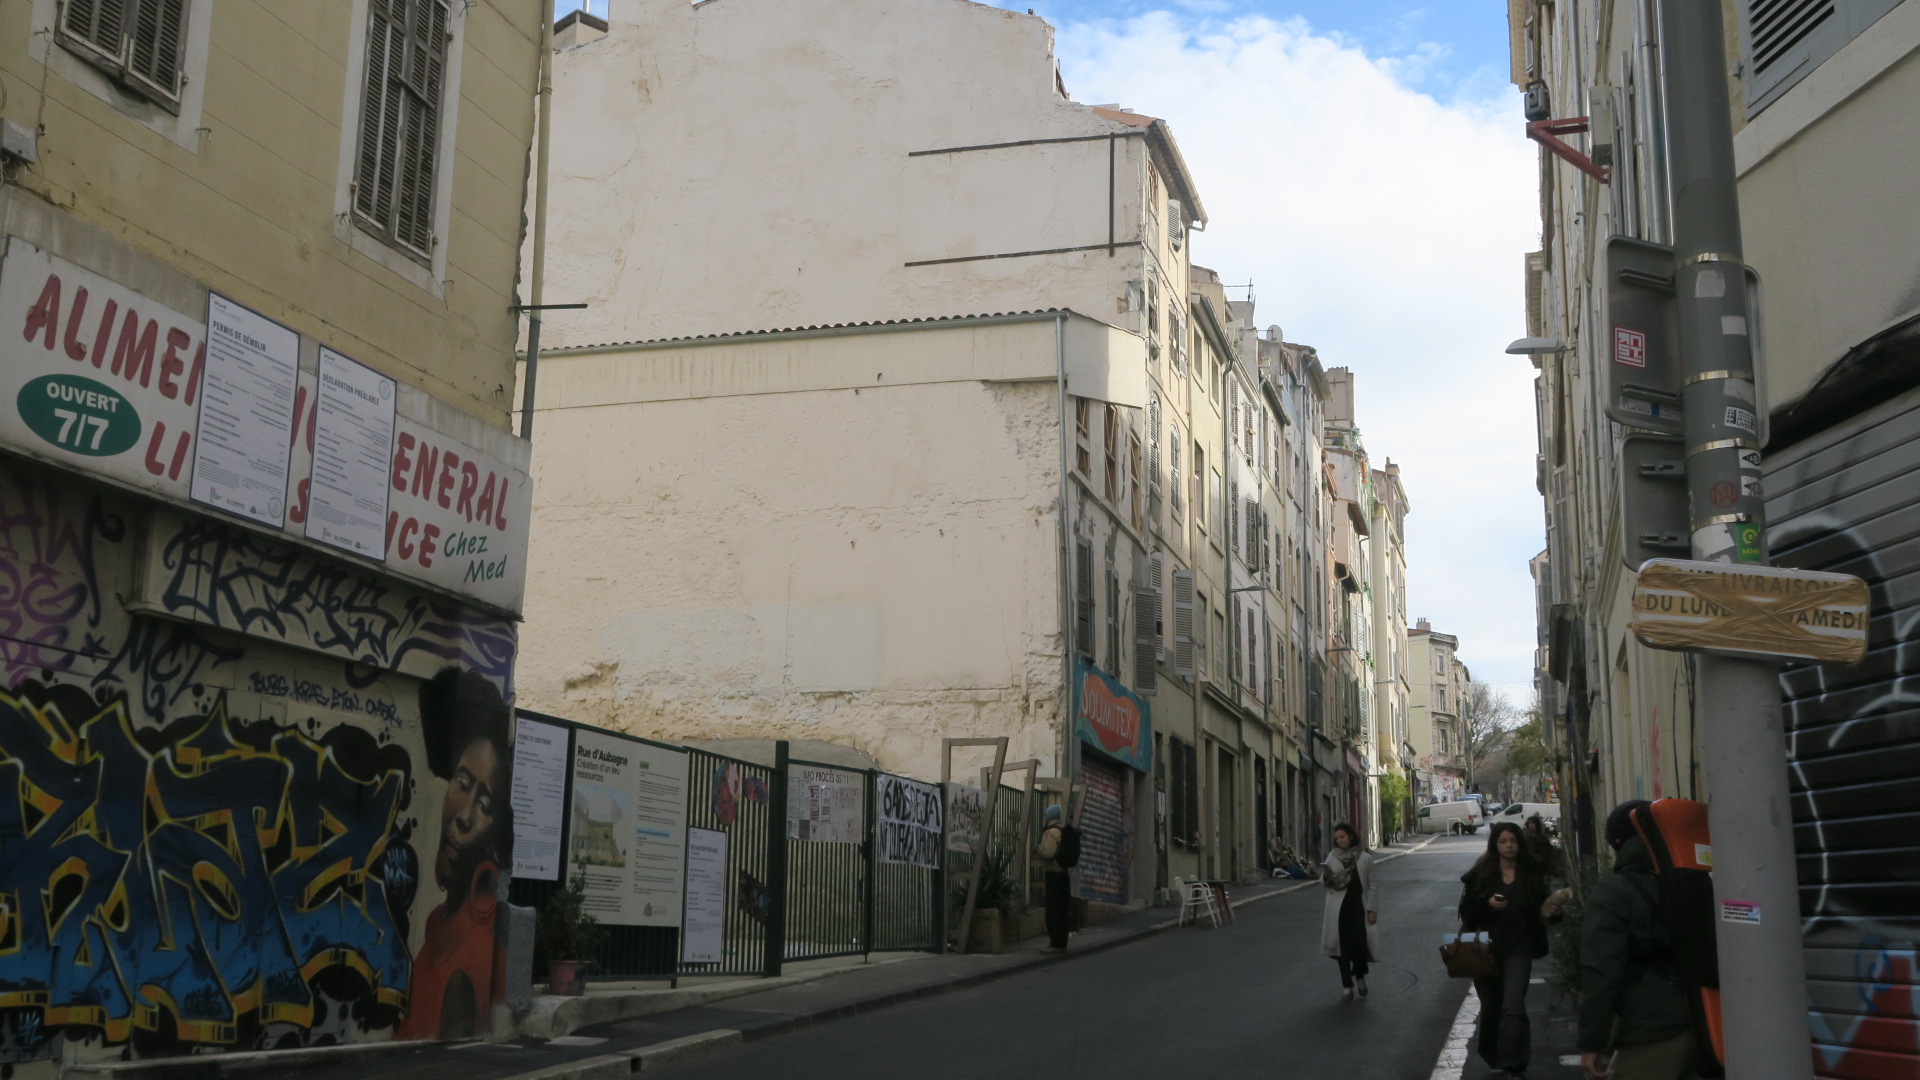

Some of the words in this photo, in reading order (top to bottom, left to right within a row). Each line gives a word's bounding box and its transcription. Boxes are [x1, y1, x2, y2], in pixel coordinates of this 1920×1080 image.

[213, 321, 234, 336] PERMIS
[235, 331, 242, 341] DE
[243, 335, 266, 352] DÉMOLIR
[46, 382, 119, 412] OUVERT
[323, 373, 354, 394] DÉCLARATION
[354, 388, 380, 406] PRÉALABLE
[54, 408, 109, 450] 7/7
[145, 420, 191, 481] LI
[392, 432, 509, 531] ENERAL
[444, 531, 487, 557] Chez
[464, 555, 507, 583] Med
[1647, 593, 1673, 612] DU
[577, 758, 599, 771] Création
[599, 763, 611, 773] d'un
[611, 765, 620, 775] lieu
[578, 745, 591, 758] Rue
[592, 748, 628, 766] d'Aubagne
[576, 770, 604, 782] ressources
[816, 770, 835, 783] PROCÈS
